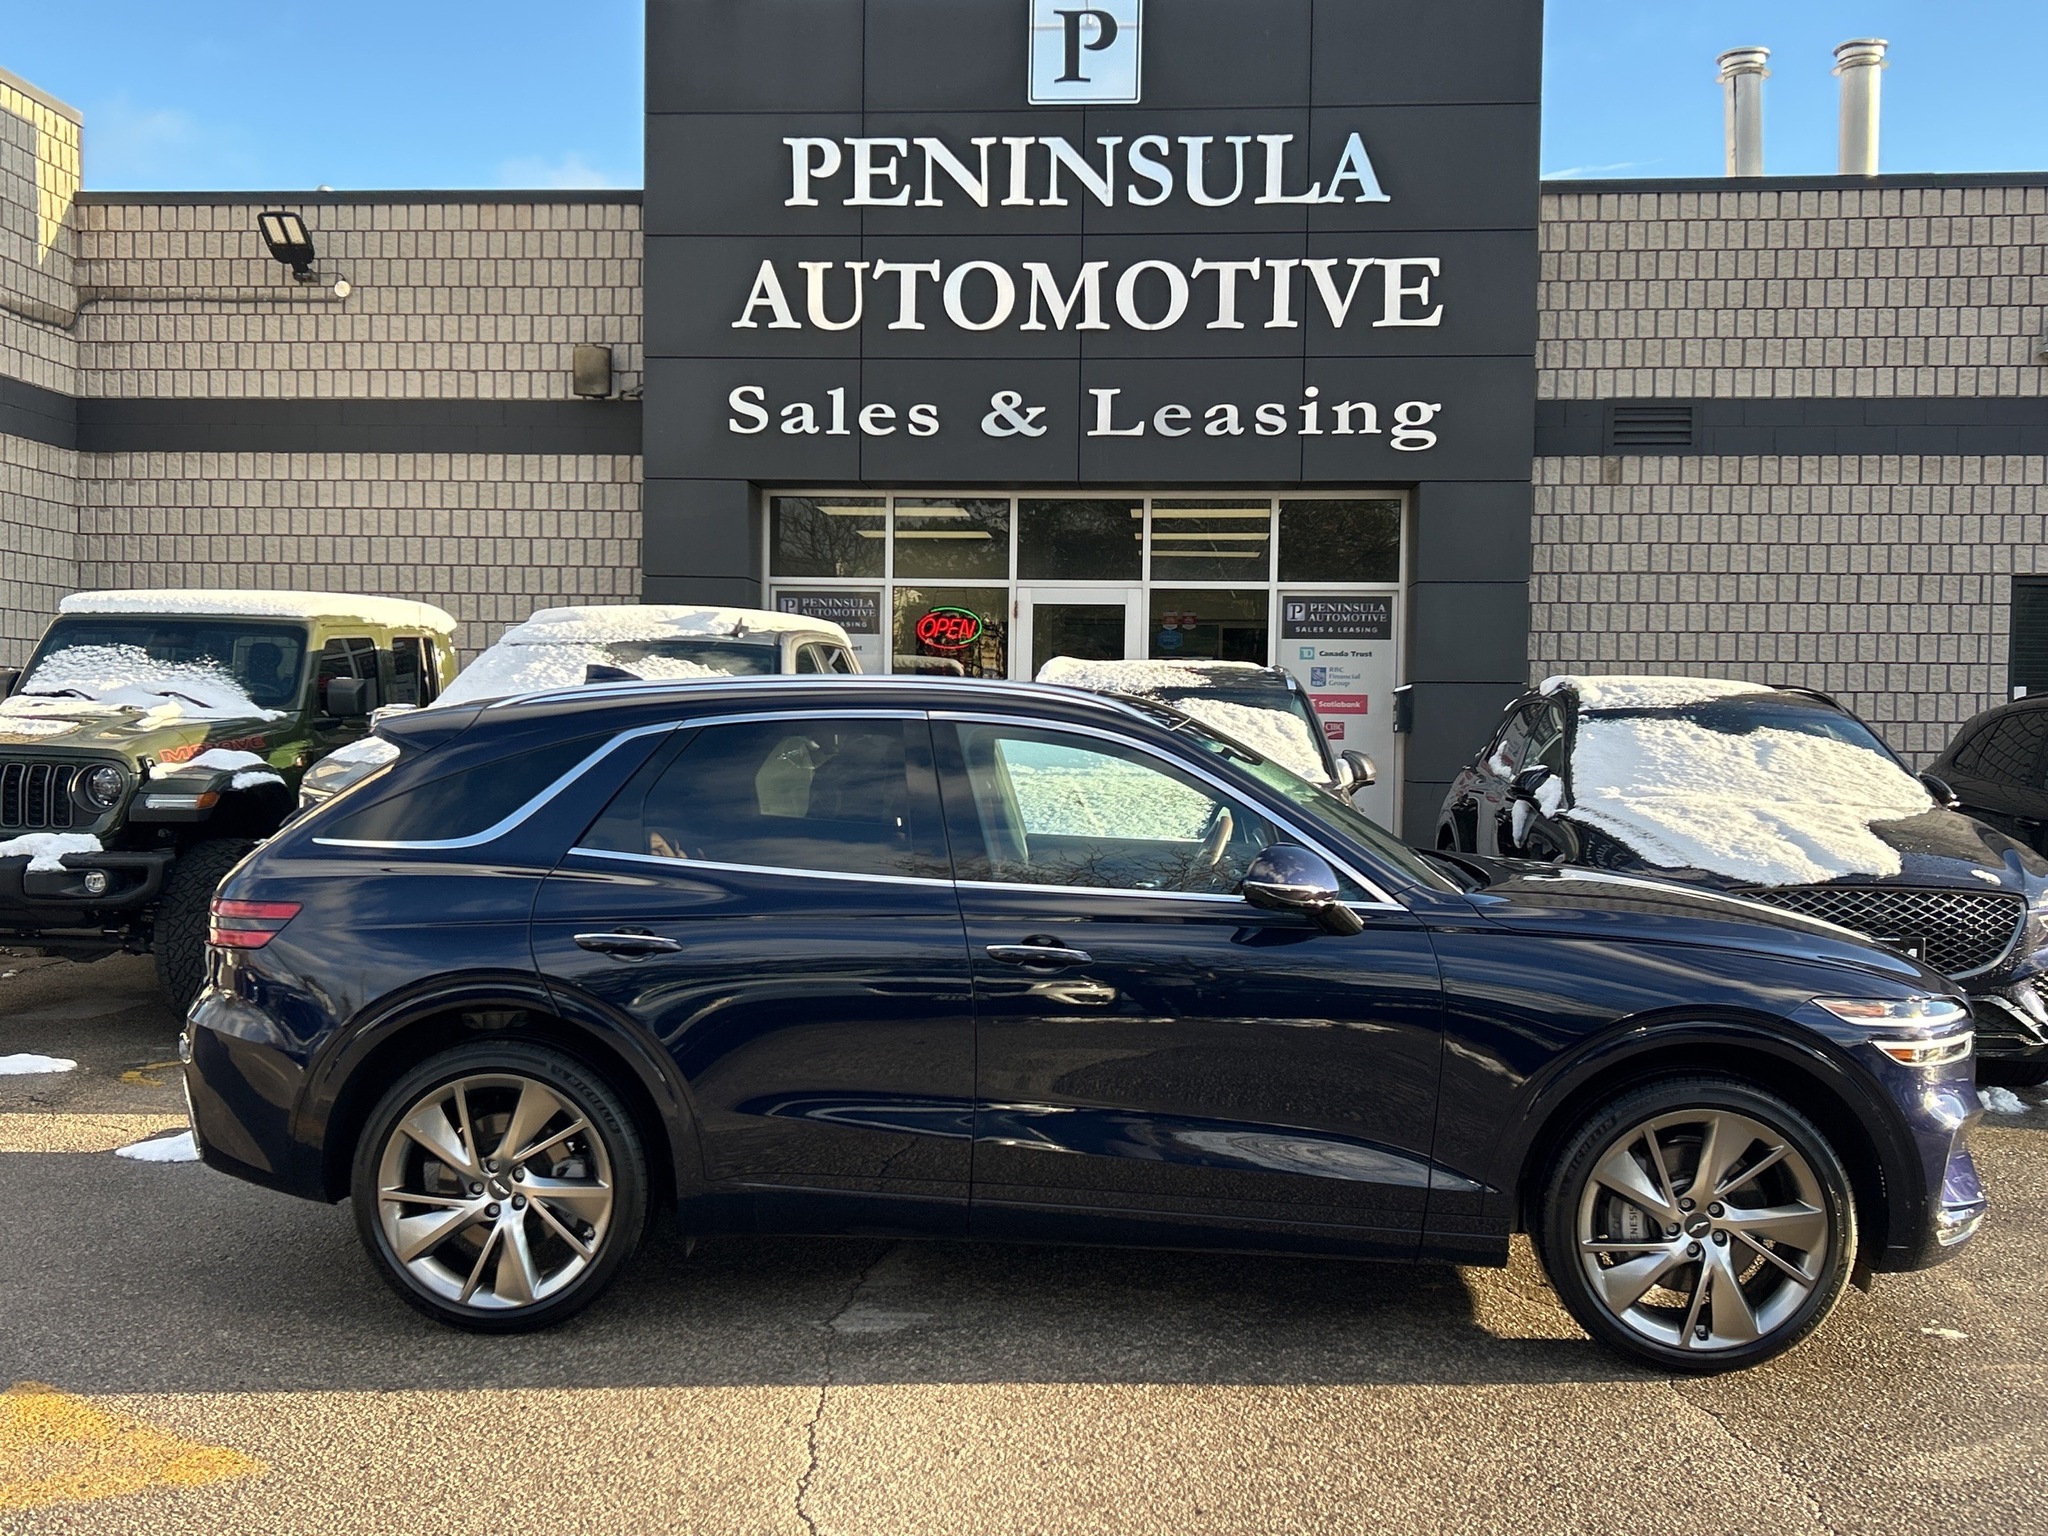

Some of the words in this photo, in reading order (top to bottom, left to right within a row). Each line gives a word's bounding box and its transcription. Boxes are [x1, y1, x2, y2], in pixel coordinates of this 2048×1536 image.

[1054, 10, 1118, 83] P
[782, 132, 1391, 208] PENINSULA
[732, 257, 1443, 331] AUTOMOTIVE
[728, 385, 940, 437] Sales
[981, 391, 1047, 438] &
[1087, 386, 1442, 452] Leasing
[802, 598, 874, 608] PENINSULA
[1309, 603, 1386, 612] PENINSULA
[801, 608, 876, 617] AUTOMOTIVE
[1289, 604, 1303, 620] P
[1308, 613, 1387, 622] AUTOMOTIVE
[921, 617, 976, 639] OPEN
[1337, 626, 1378, 634] LEASING
[1301, 649, 1313, 658] TD
[1318, 700, 1361, 708] Scotiabank
[1325, 723, 1344, 731] CIBC
